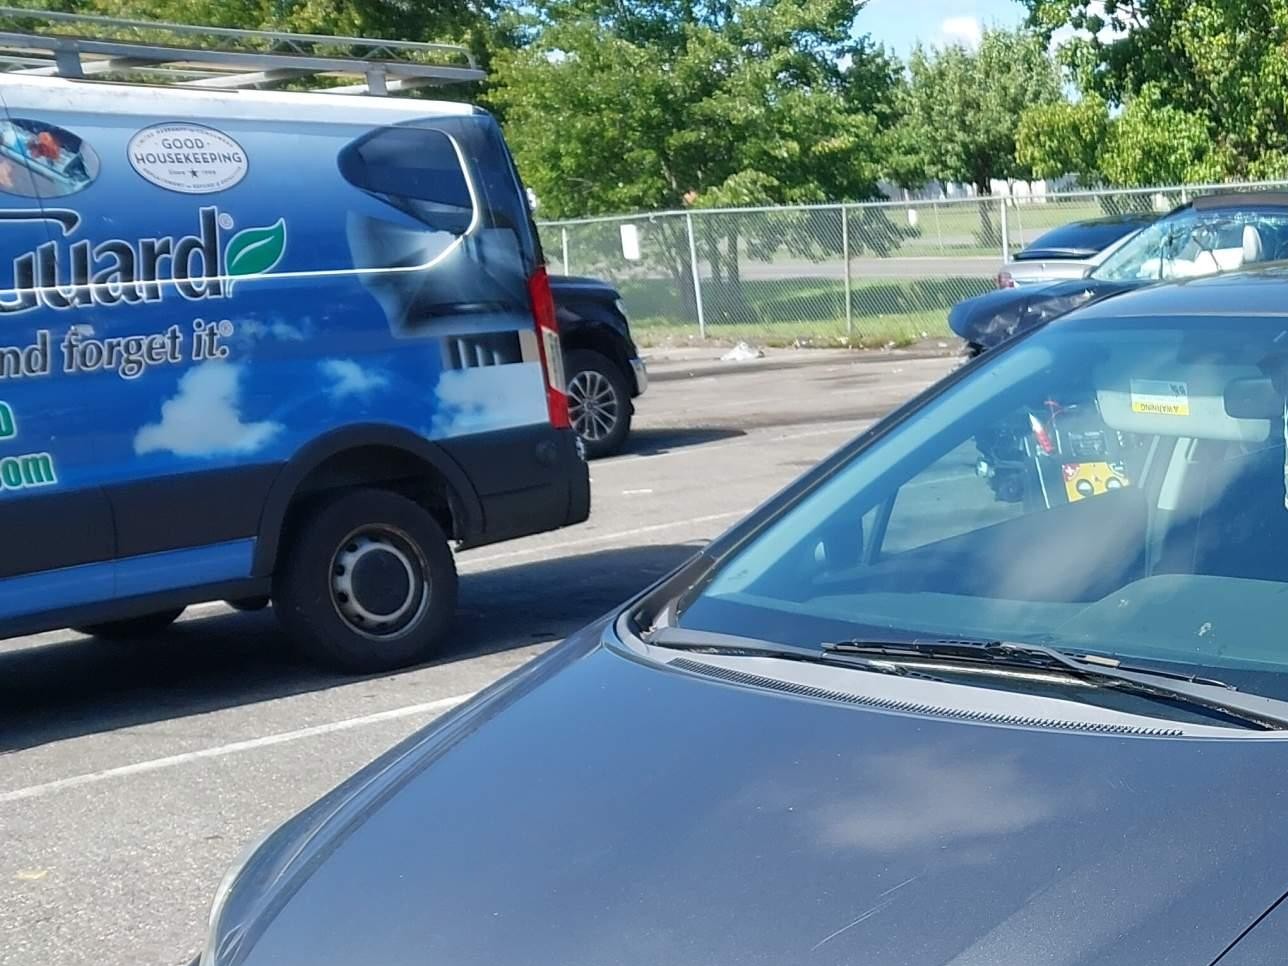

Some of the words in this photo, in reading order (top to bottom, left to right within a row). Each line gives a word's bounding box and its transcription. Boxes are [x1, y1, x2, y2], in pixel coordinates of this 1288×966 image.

[161, 138, 205, 149] GOOD
[134, 152, 242, 164] HOUSEKEEPING
[61, 325, 183, 379] forget
